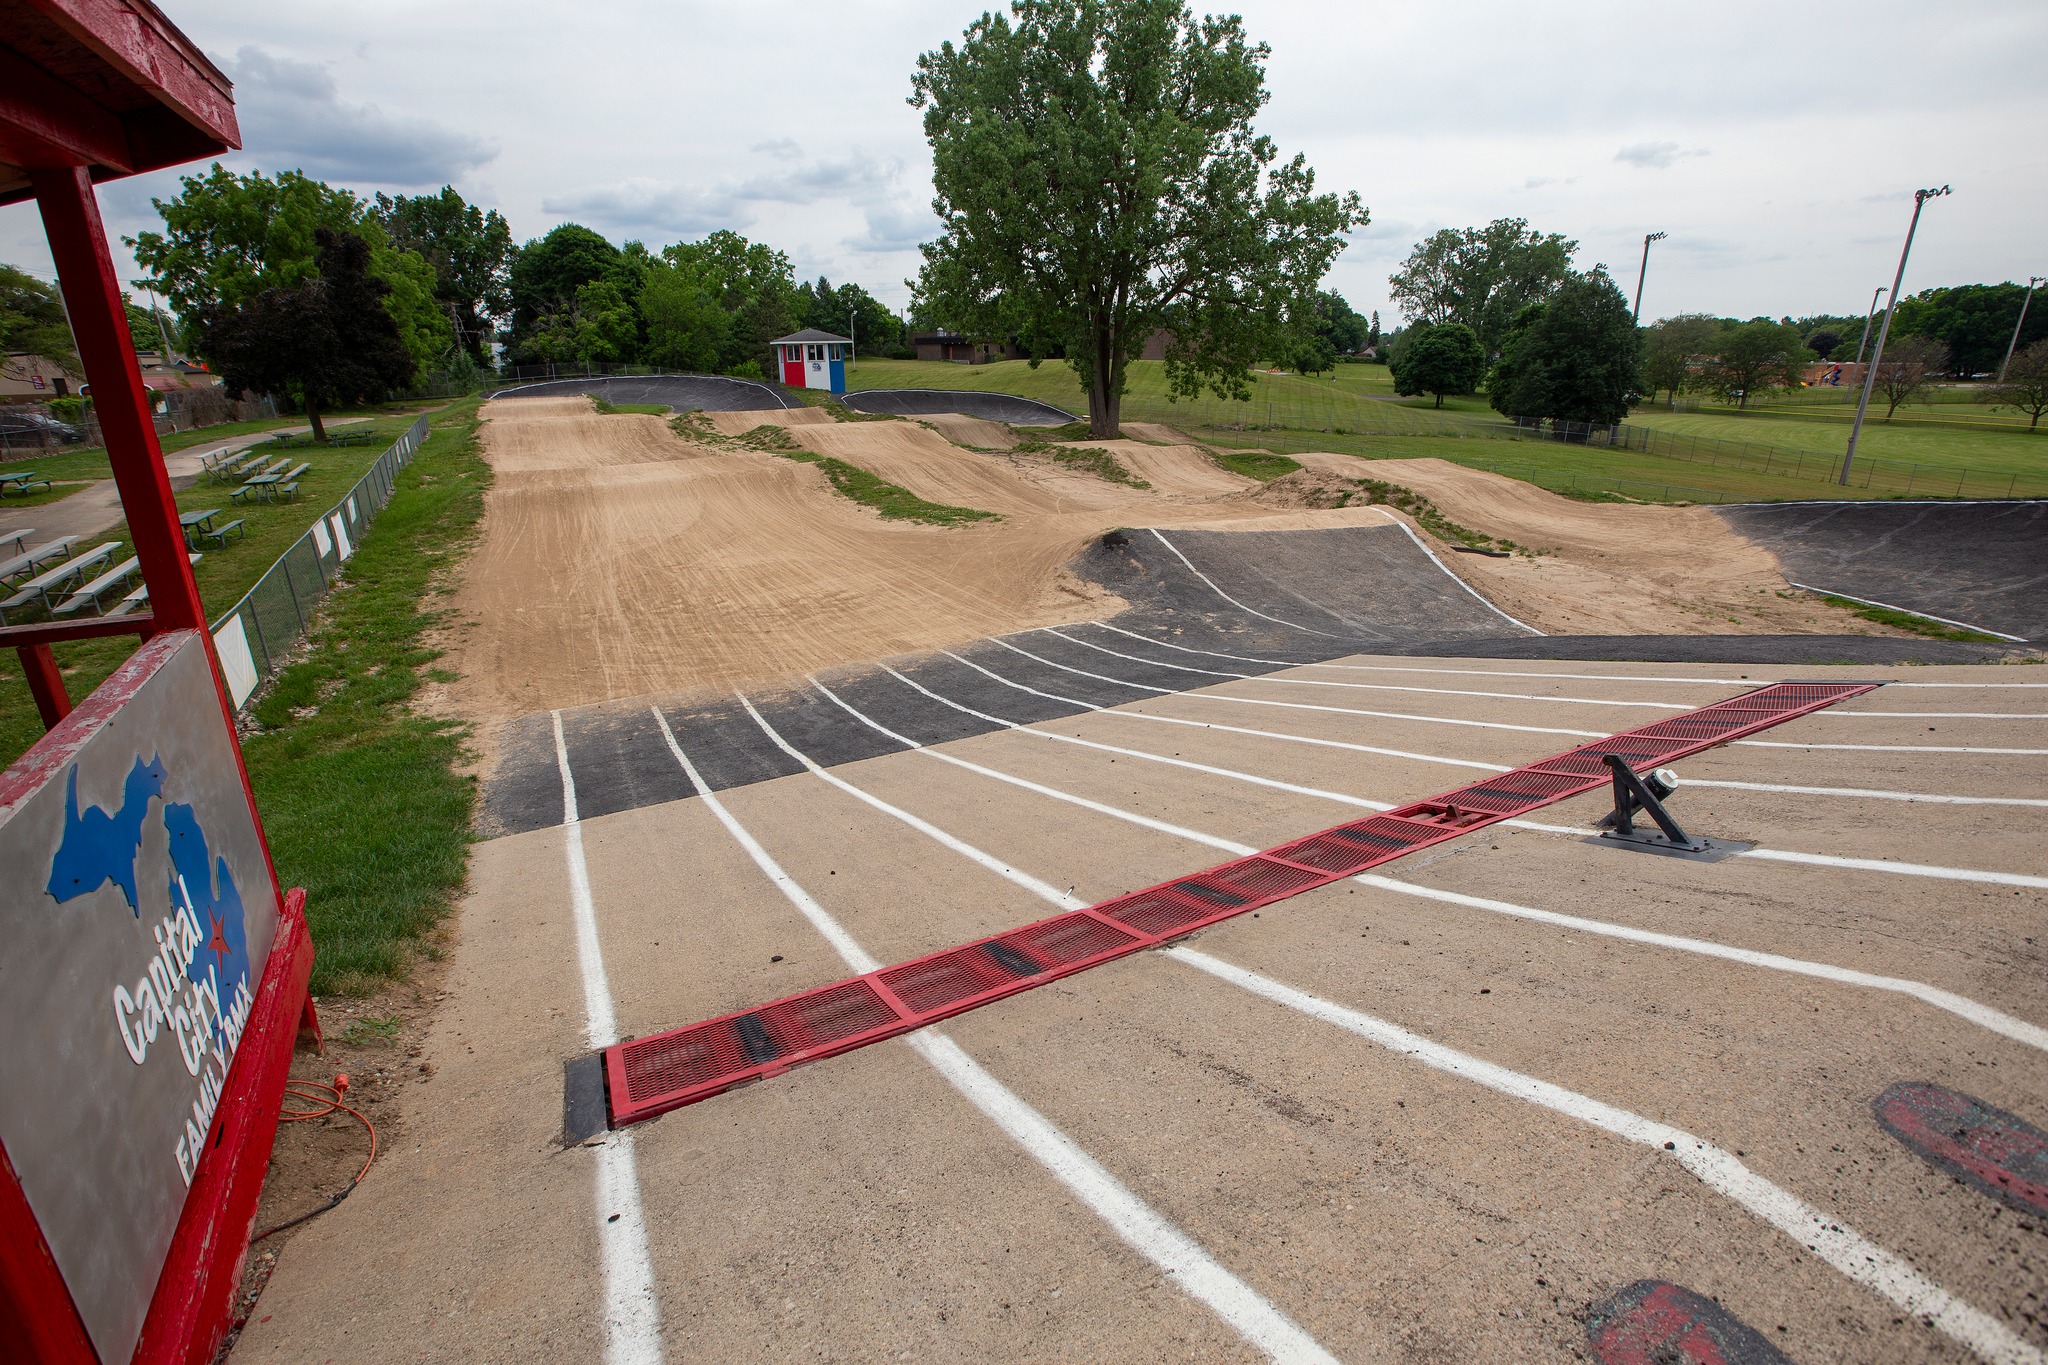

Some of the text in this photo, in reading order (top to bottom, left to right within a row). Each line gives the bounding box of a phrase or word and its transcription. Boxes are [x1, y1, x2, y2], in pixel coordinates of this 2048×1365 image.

[114, 874, 203, 1065] Capital
[175, 964, 224, 1076] City
[174, 971, 253, 1188] FAMILY BMX
